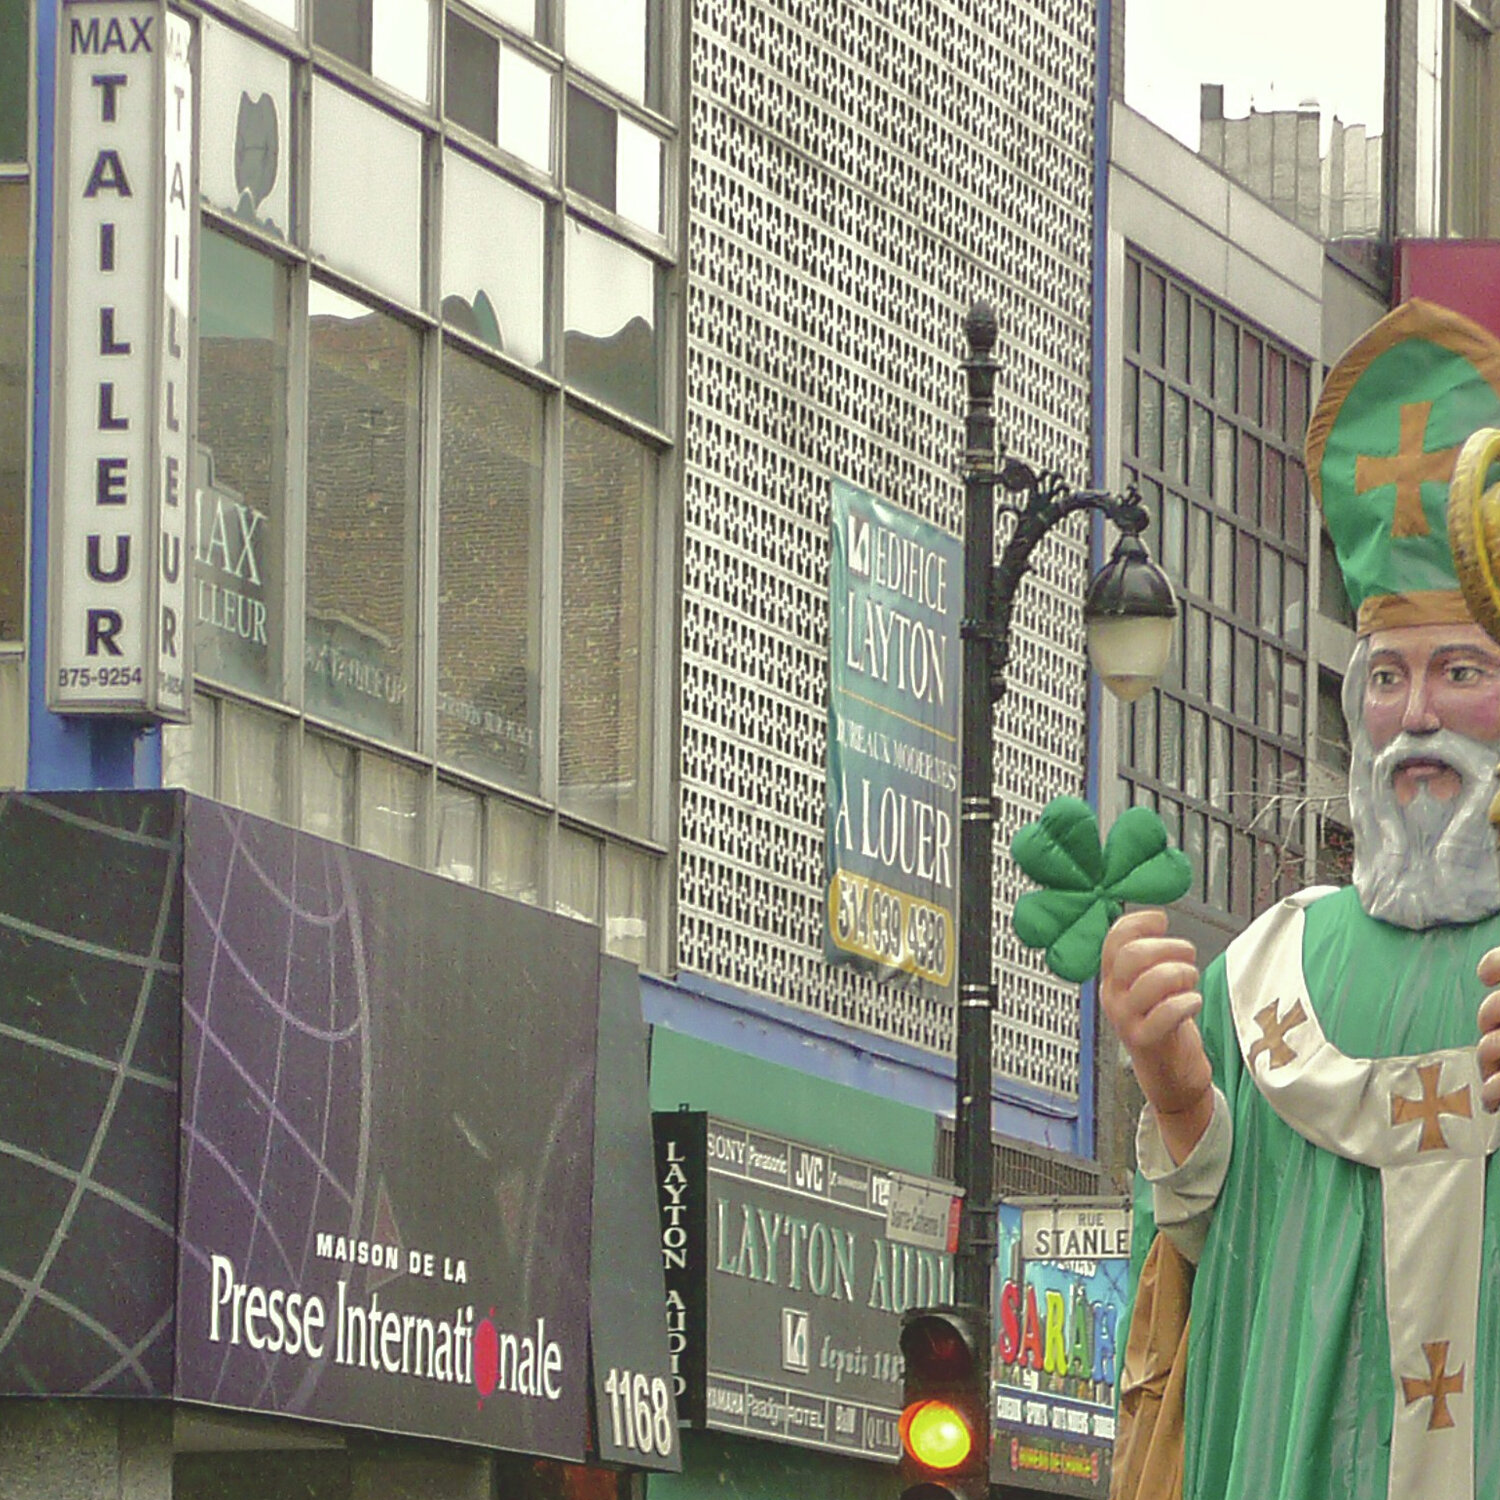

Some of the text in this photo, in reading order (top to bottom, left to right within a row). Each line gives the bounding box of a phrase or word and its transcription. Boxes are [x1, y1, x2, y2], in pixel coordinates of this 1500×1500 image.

[70, 17, 154, 54] MAX
[82, 74, 133, 657] TAILLEUR
[161, 85, 186, 658] TAILLEUR
[58, 667, 143, 687] 875-9254
[847, 590, 948, 706] LAYTON
[861, 778, 953, 889] LOUER
[707, 1132, 747, 1166] SONY
[796, 1152, 823, 1192] JVC
[662, 1141, 688, 1270] LAYTON
[716, 1197, 855, 1302] LAYTON
[1034, 1229, 1129, 1256] STANLE
[1078, 1212, 1104, 1226] RUE
[316, 1232, 469, 1285] MAISON DE LA
[209, 1253, 563, 1402] Presse Internationale
[604, 1368, 672, 1457] 1168
